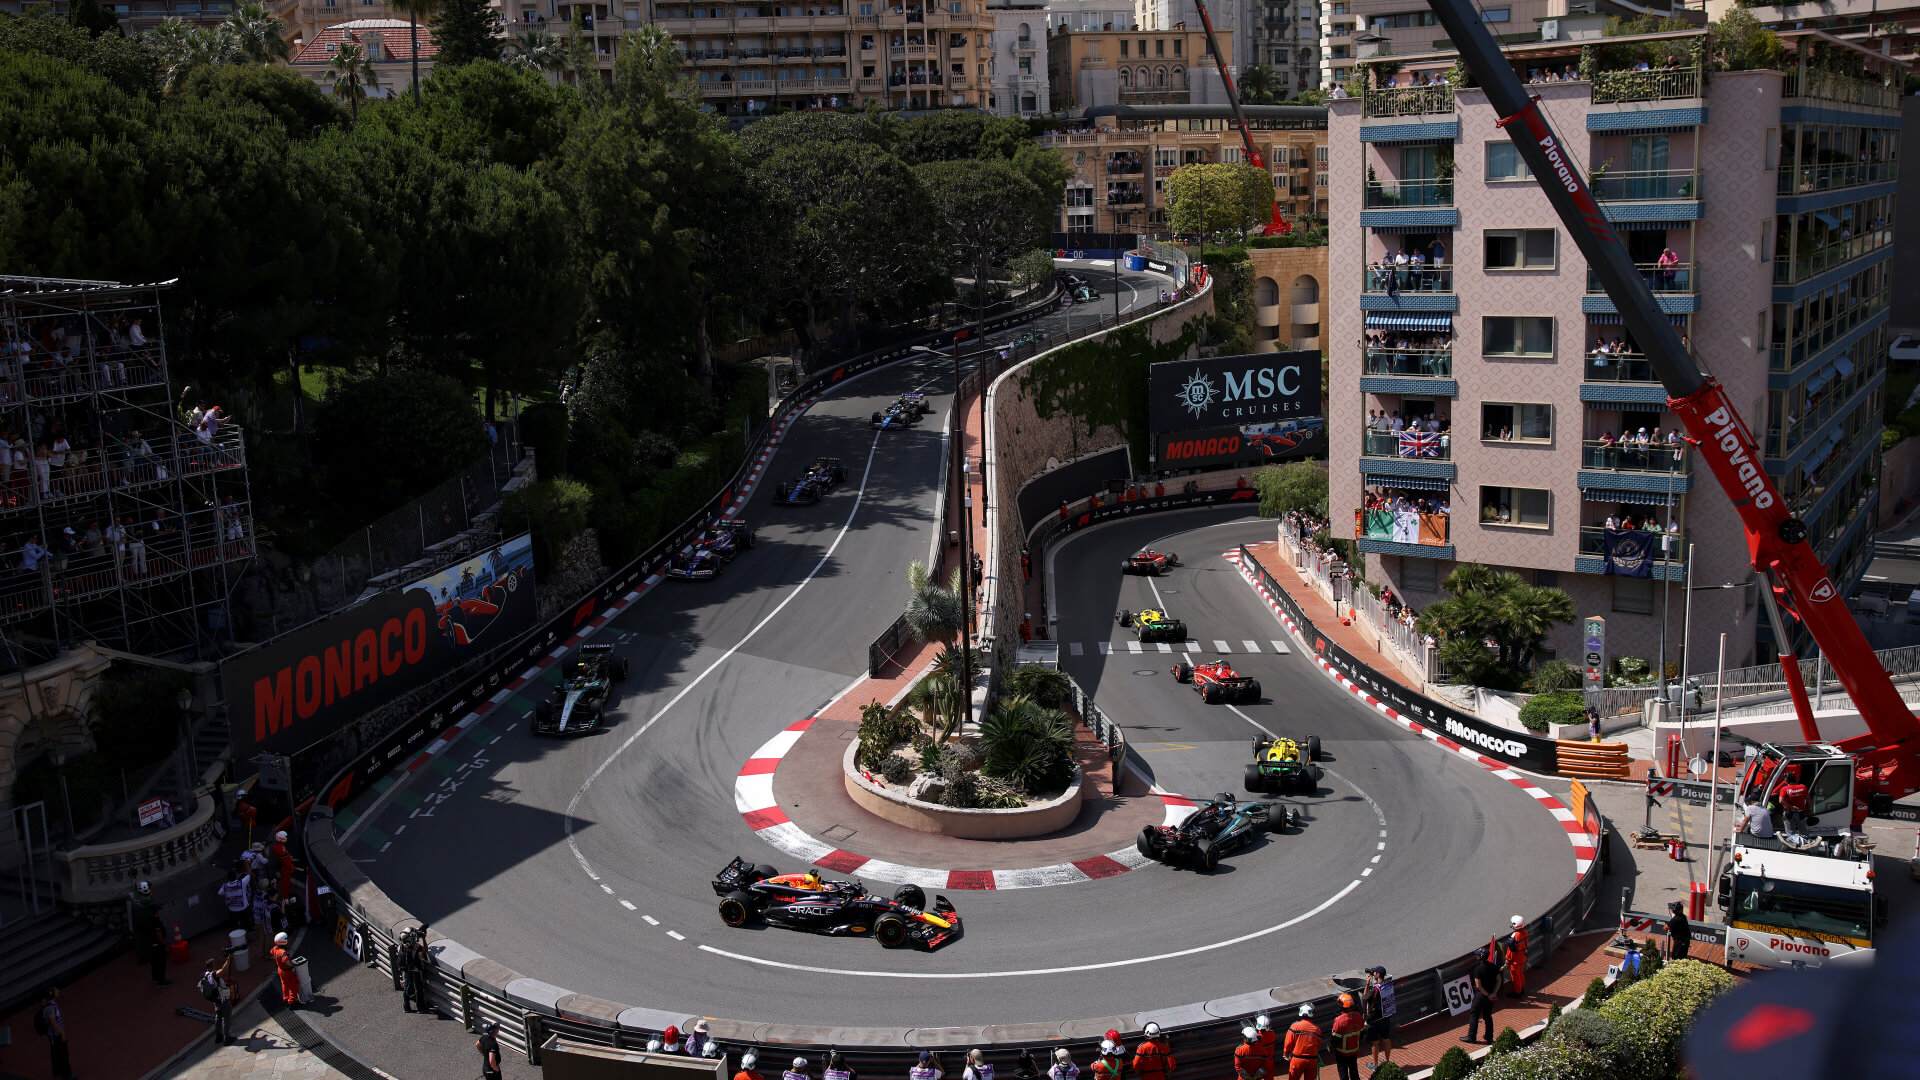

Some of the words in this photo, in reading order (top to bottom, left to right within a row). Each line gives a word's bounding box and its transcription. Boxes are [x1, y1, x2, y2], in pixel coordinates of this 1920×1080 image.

[1539, 135, 1579, 193] Piovano
[1222, 365, 1300, 402] MSC
[1222, 401, 1301, 418] CRUISES
[1165, 435, 1241, 460] MONACO
[1704, 405, 1774, 509] Piovano
[254, 607, 427, 743] MONACO
[1445, 716, 1528, 758] #MonacoGP
[1681, 788, 1723, 801] Piovao
[788, 905, 834, 916] ORACLE
[346, 929, 360, 954] SC
[1770, 938, 1830, 957] Piovano
[1448, 981, 1472, 1009] SC
